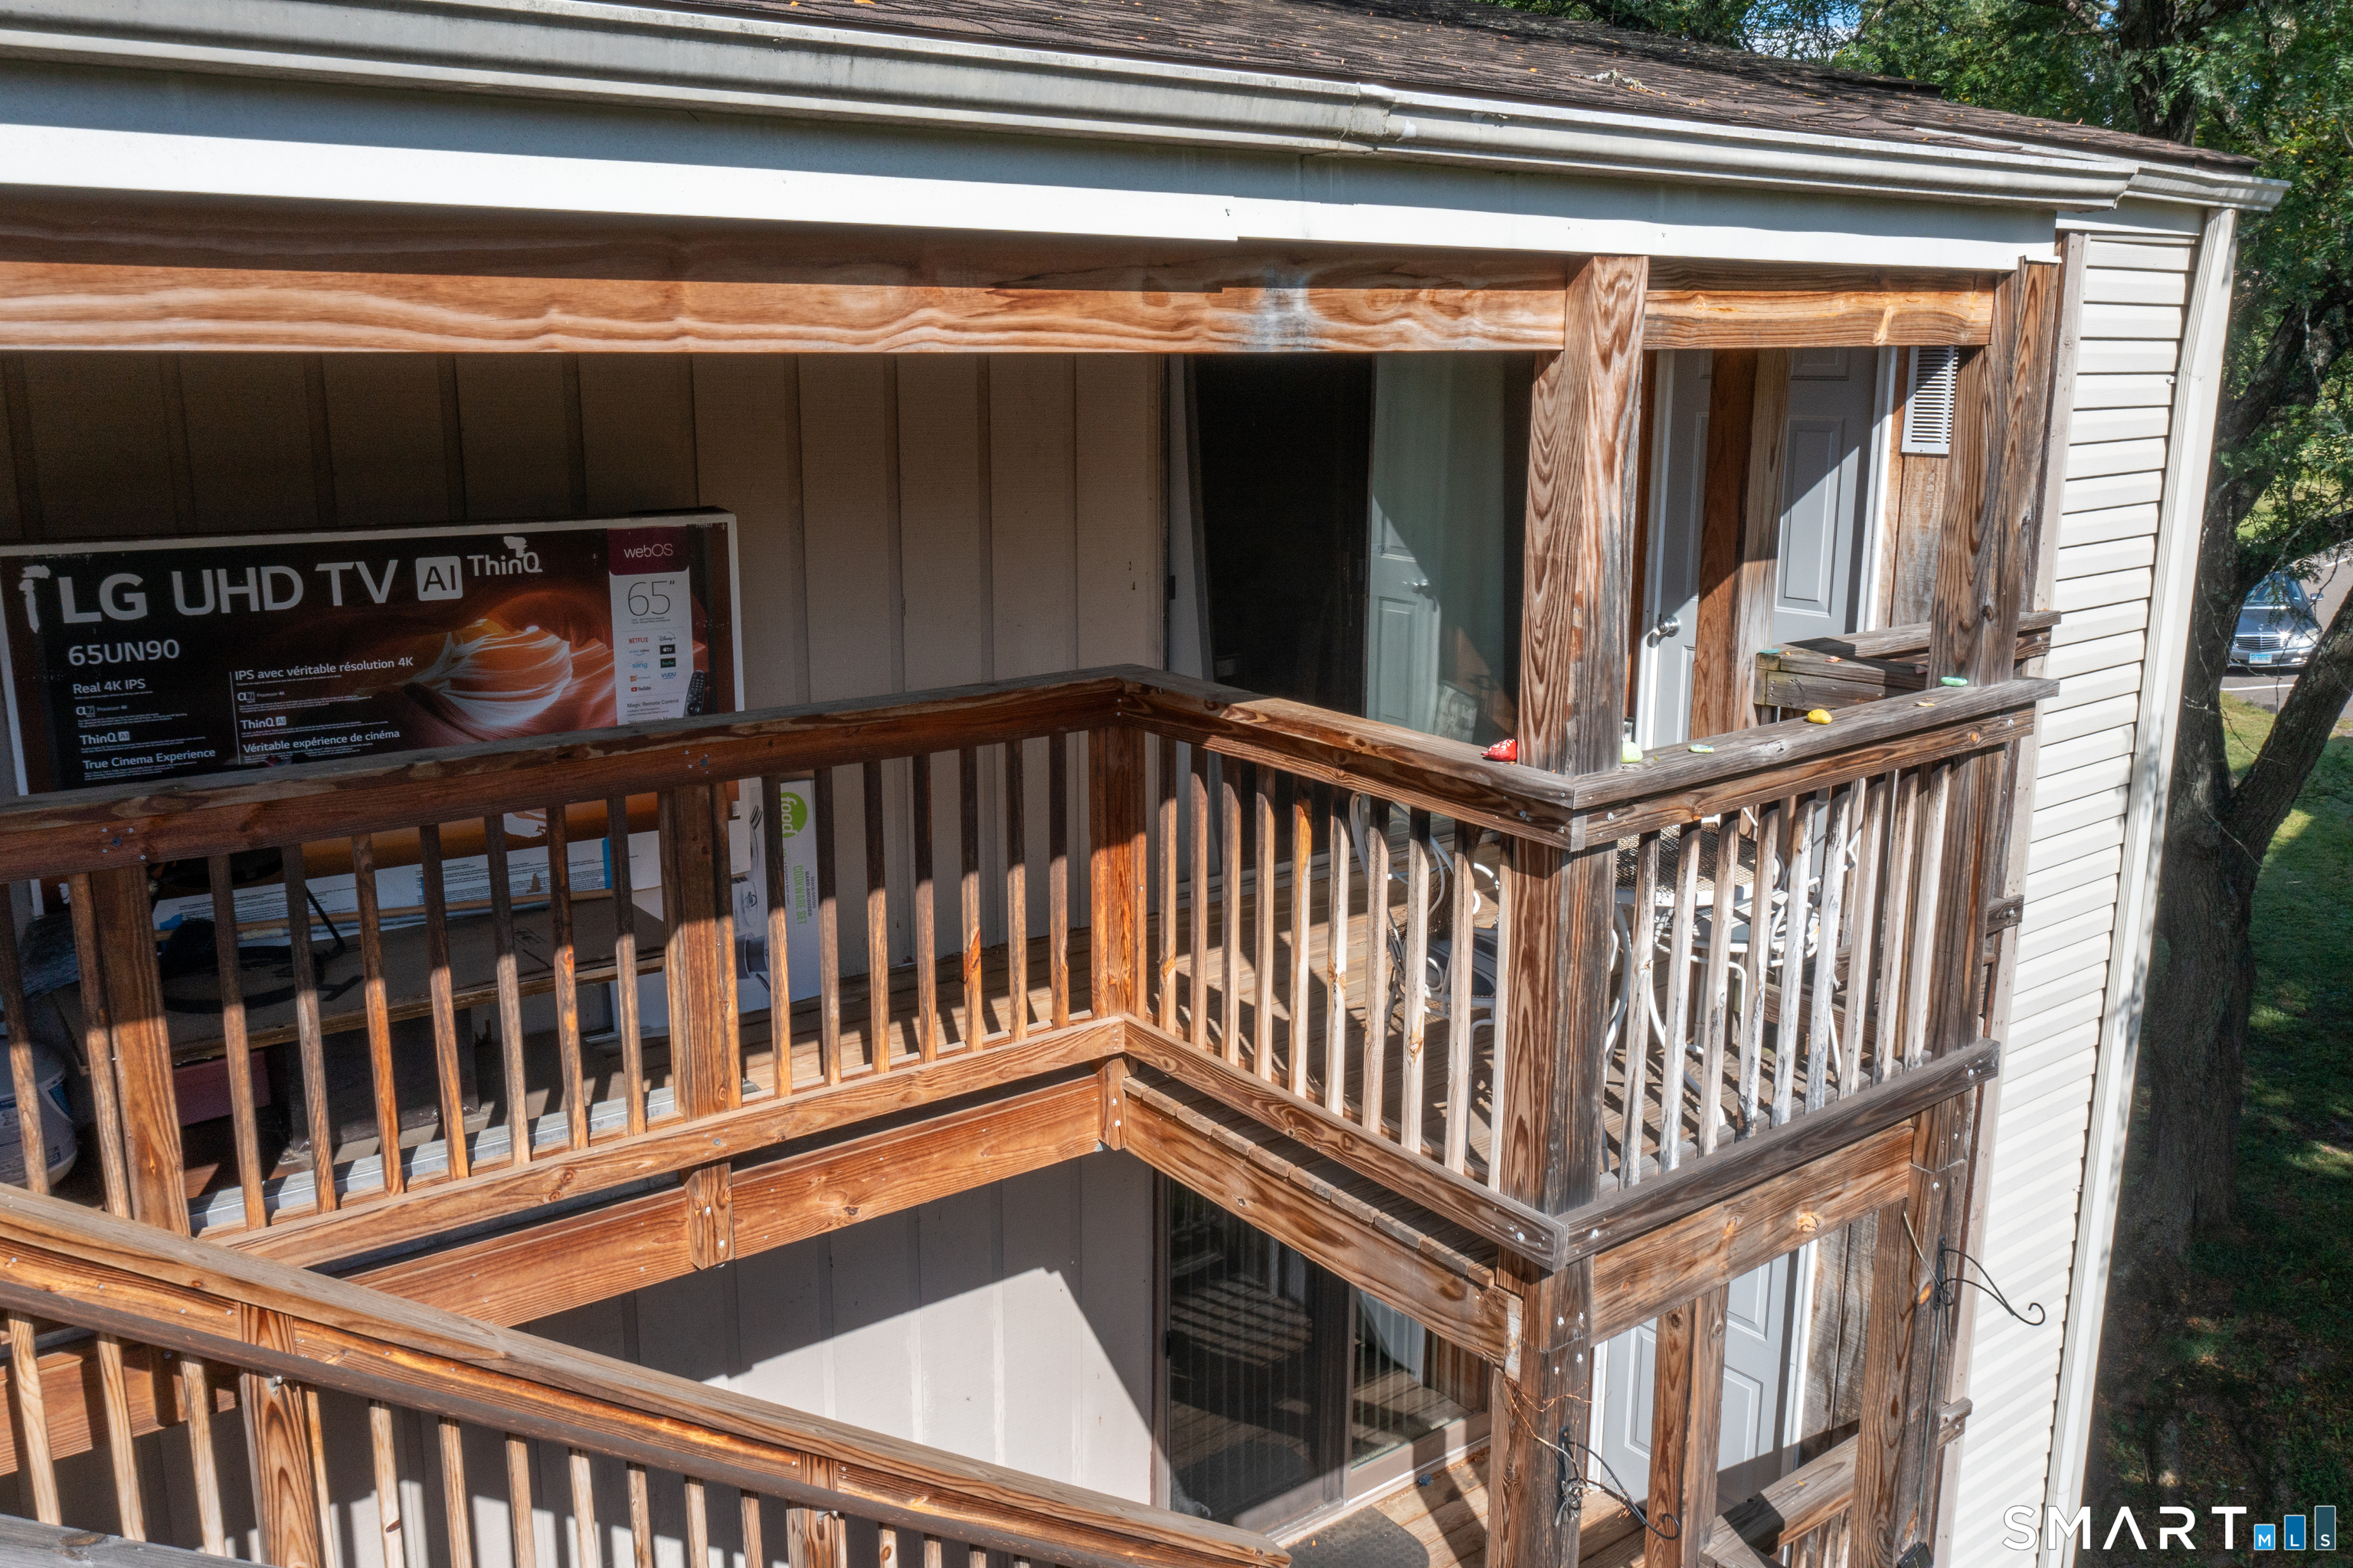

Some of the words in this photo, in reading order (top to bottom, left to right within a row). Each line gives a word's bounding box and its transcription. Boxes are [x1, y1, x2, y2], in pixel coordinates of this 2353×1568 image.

[623, 543, 673, 558] webOS
[57, 573, 148, 624] LG
[172, 565, 304, 616] UHD
[315, 559, 398, 607] TV
[423, 565, 457, 592] AI
[467, 552, 543, 577] ThinQ
[68, 639, 180, 666] 65UN90
[235, 669, 255, 681] IPS
[257, 669, 283, 679] avec
[286, 663, 337, 677] véritable
[339, 658, 395, 673] résolution
[398, 656, 414, 666] 4K
[73, 683, 101, 694] Real
[104, 680, 122, 692] 4K
[125, 678, 146, 689] IPS
[240, 718, 276, 729] ThinQ
[79, 732, 117, 745] ThinQ
[243, 739, 290, 753] Véritable
[293, 735, 348, 749] expérience
[350, 732, 363, 742] de
[365, 730, 400, 741] cinéma
[83, 759, 109, 770] True
[111, 755, 153, 767] Cinema
[155, 749, 216, 763] Experience
[793, 865, 806, 910] COOKWARE
[796, 910, 807, 925] SET
